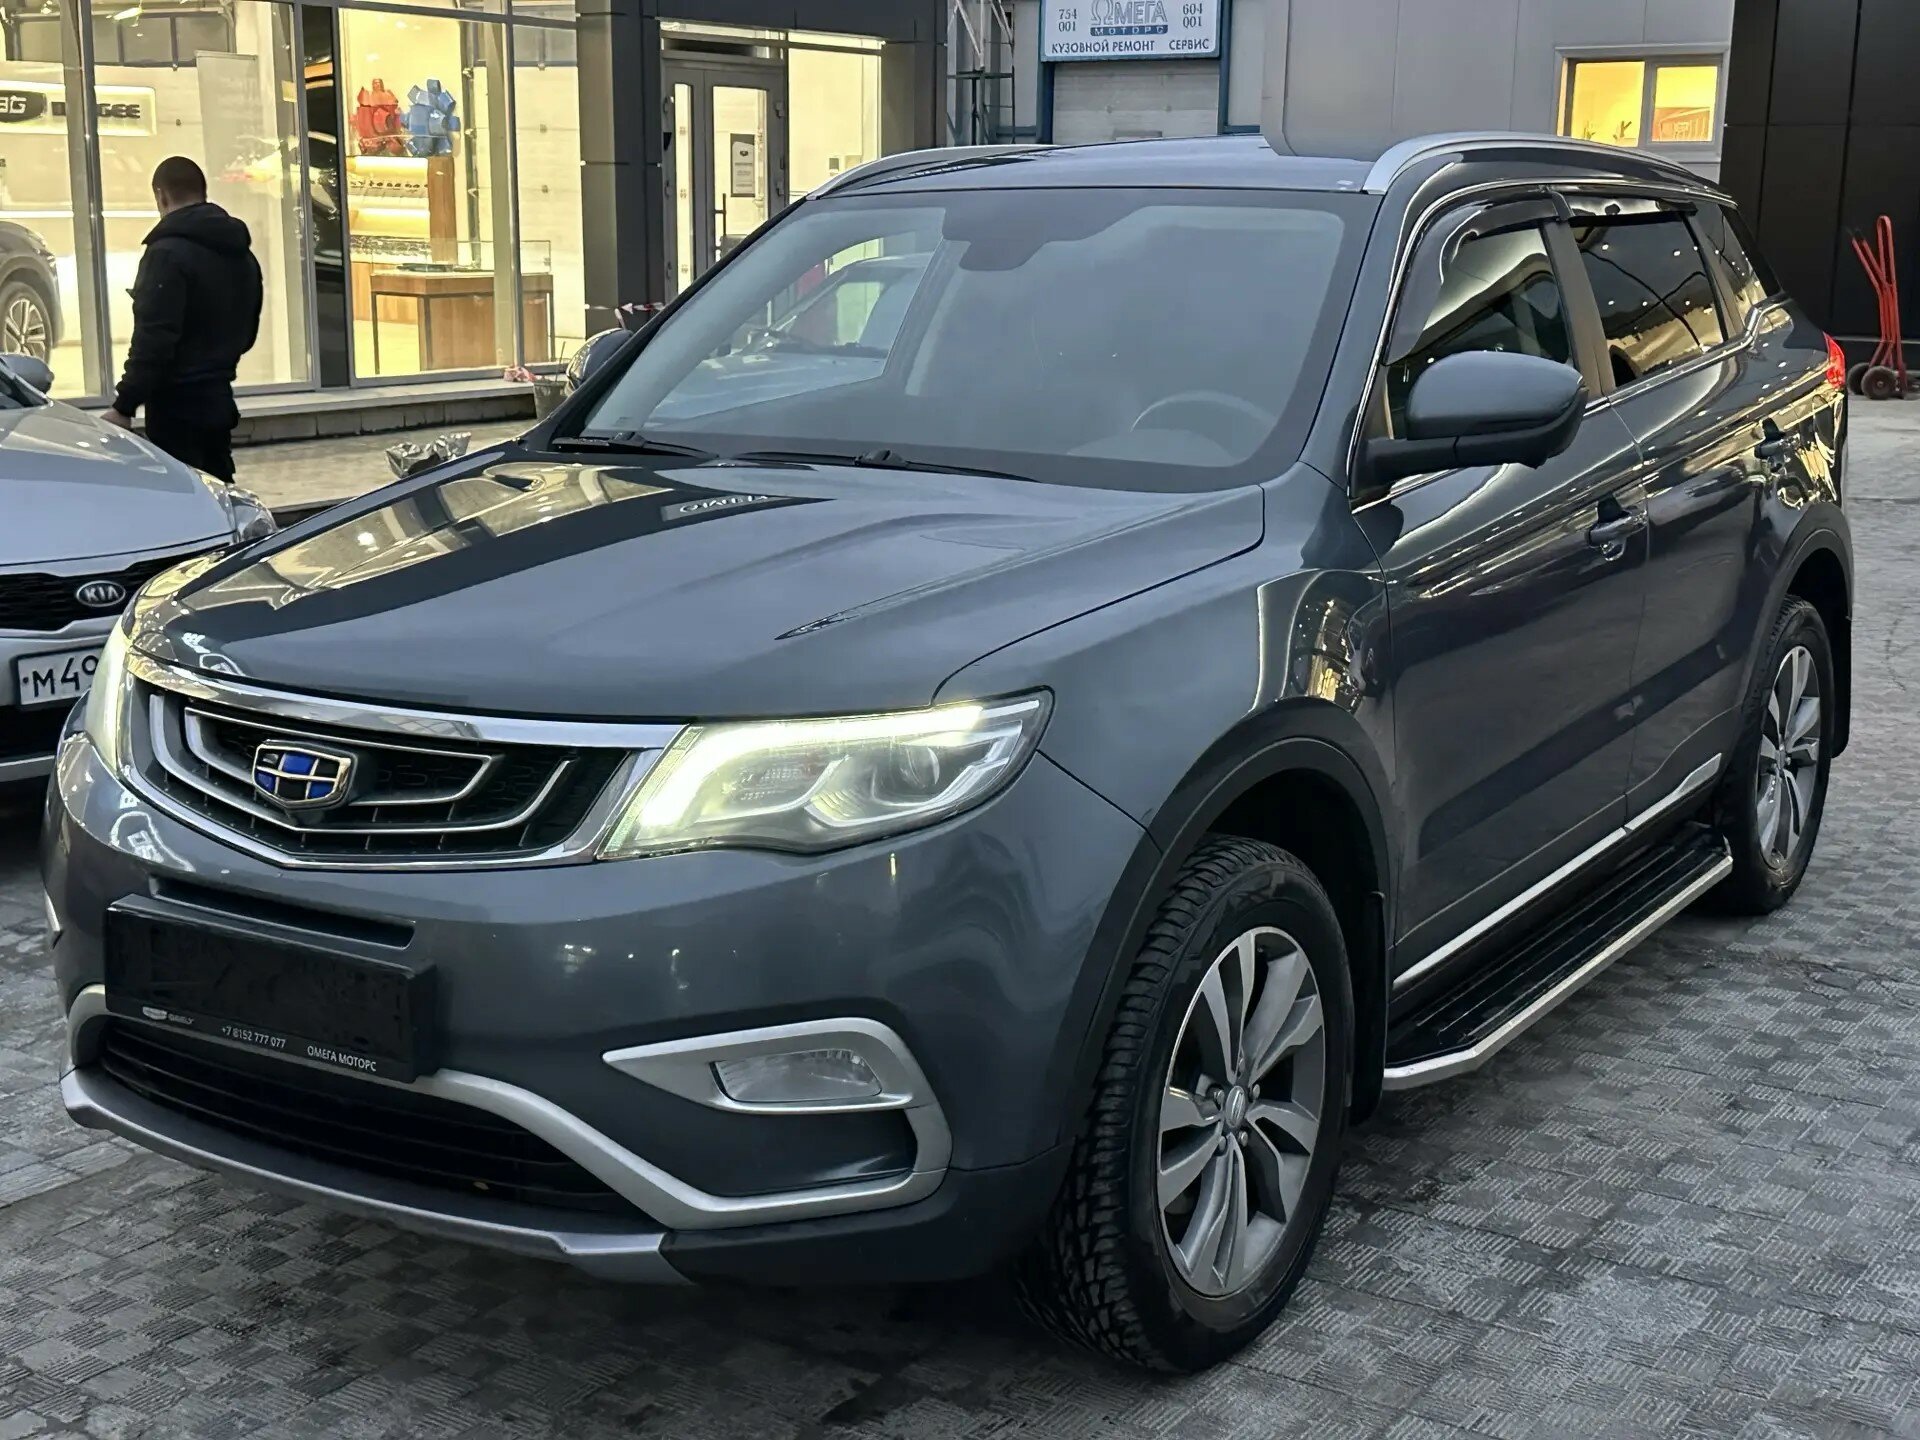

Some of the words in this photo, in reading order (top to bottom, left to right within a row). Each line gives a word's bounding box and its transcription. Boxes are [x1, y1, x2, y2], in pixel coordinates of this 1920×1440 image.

[1058, 8, 1077, 20] 754
[1182, 3, 1203, 15] 604
[1058, 21, 1077, 32] 001
[1182, 16, 1203, 28] 001
[1051, 39, 1109, 54] КУЗОВНОЙ
[1112, 40, 1155, 52] РЕМОНТ
[1168, 38, 1210, 51] СЕРВИС
[83, 586, 120, 603] KIA
[233, 1028, 252, 1041] 8152
[254, 1032, 270, 1045] 777
[270, 1037, 286, 1049] 077
[307, 1045, 337, 1062] ОМЕГА
[338, 1052, 377, 1072] МОТОРС
